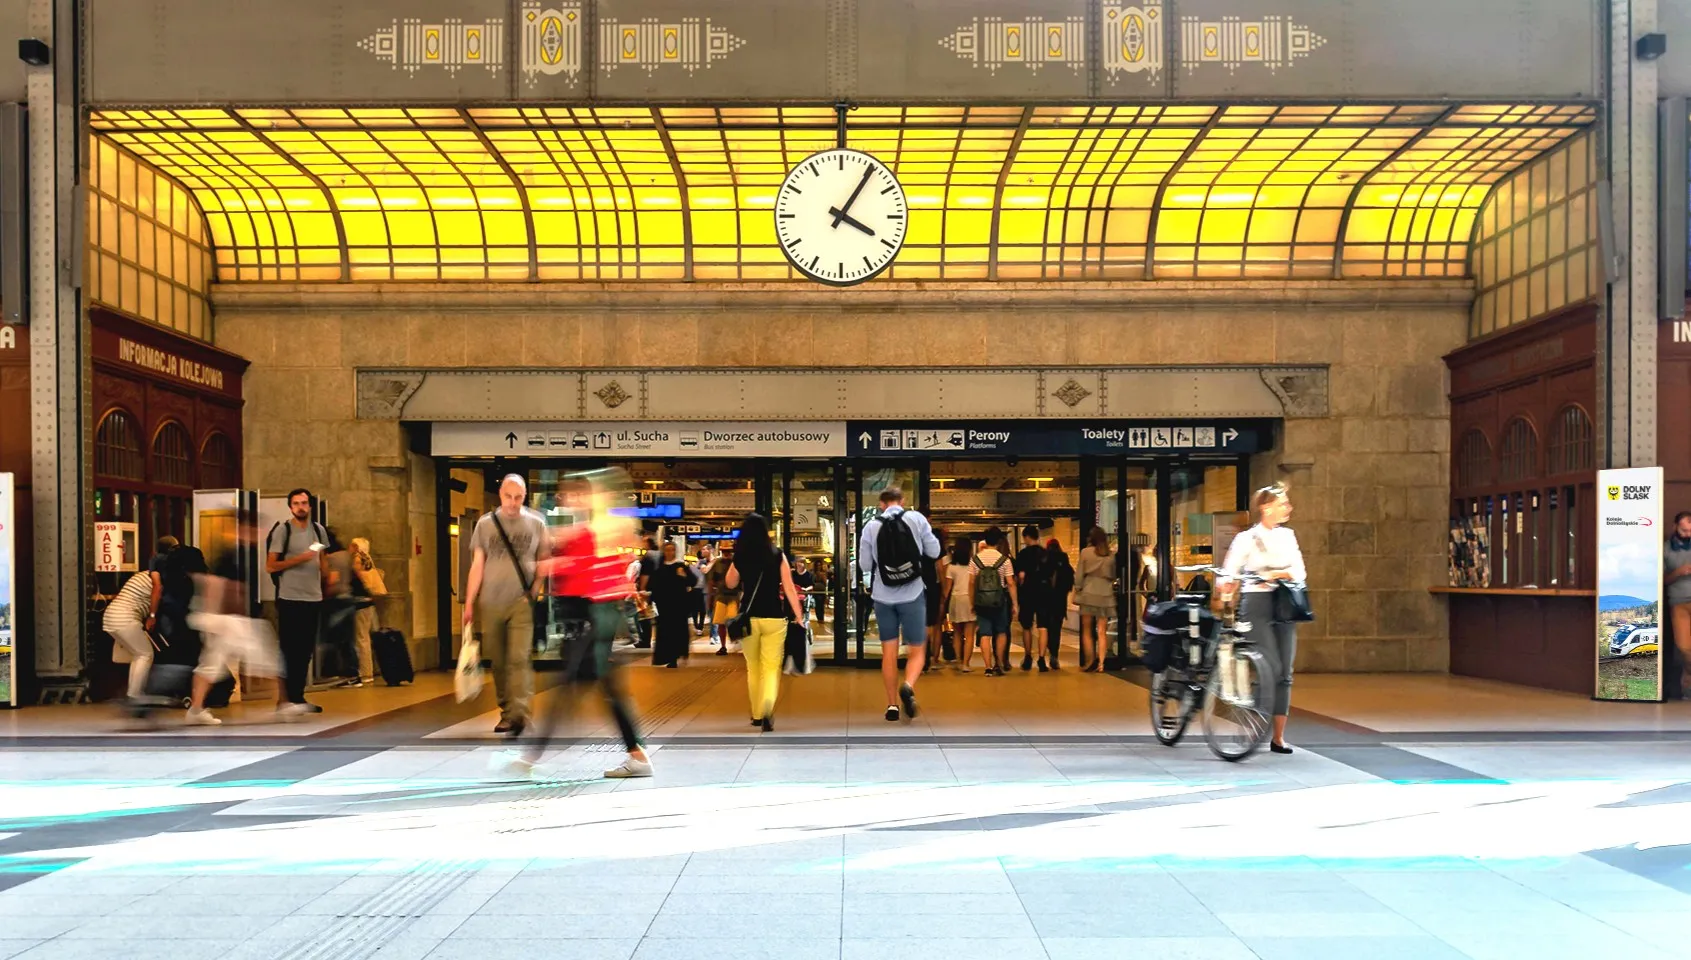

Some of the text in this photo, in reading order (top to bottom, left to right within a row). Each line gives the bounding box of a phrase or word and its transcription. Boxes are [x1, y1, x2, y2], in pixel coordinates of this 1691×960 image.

[120, 338, 223, 389] INFORMACJA KOLEJOWA
[617, 430, 669, 441] ul. Sucha
[704, 430, 830, 443] Dworzec autobusowy
[969, 430, 1010, 443] Perony
[1082, 428, 1125, 441] Toalety
[1623, 485, 1651, 493] DOLNY
